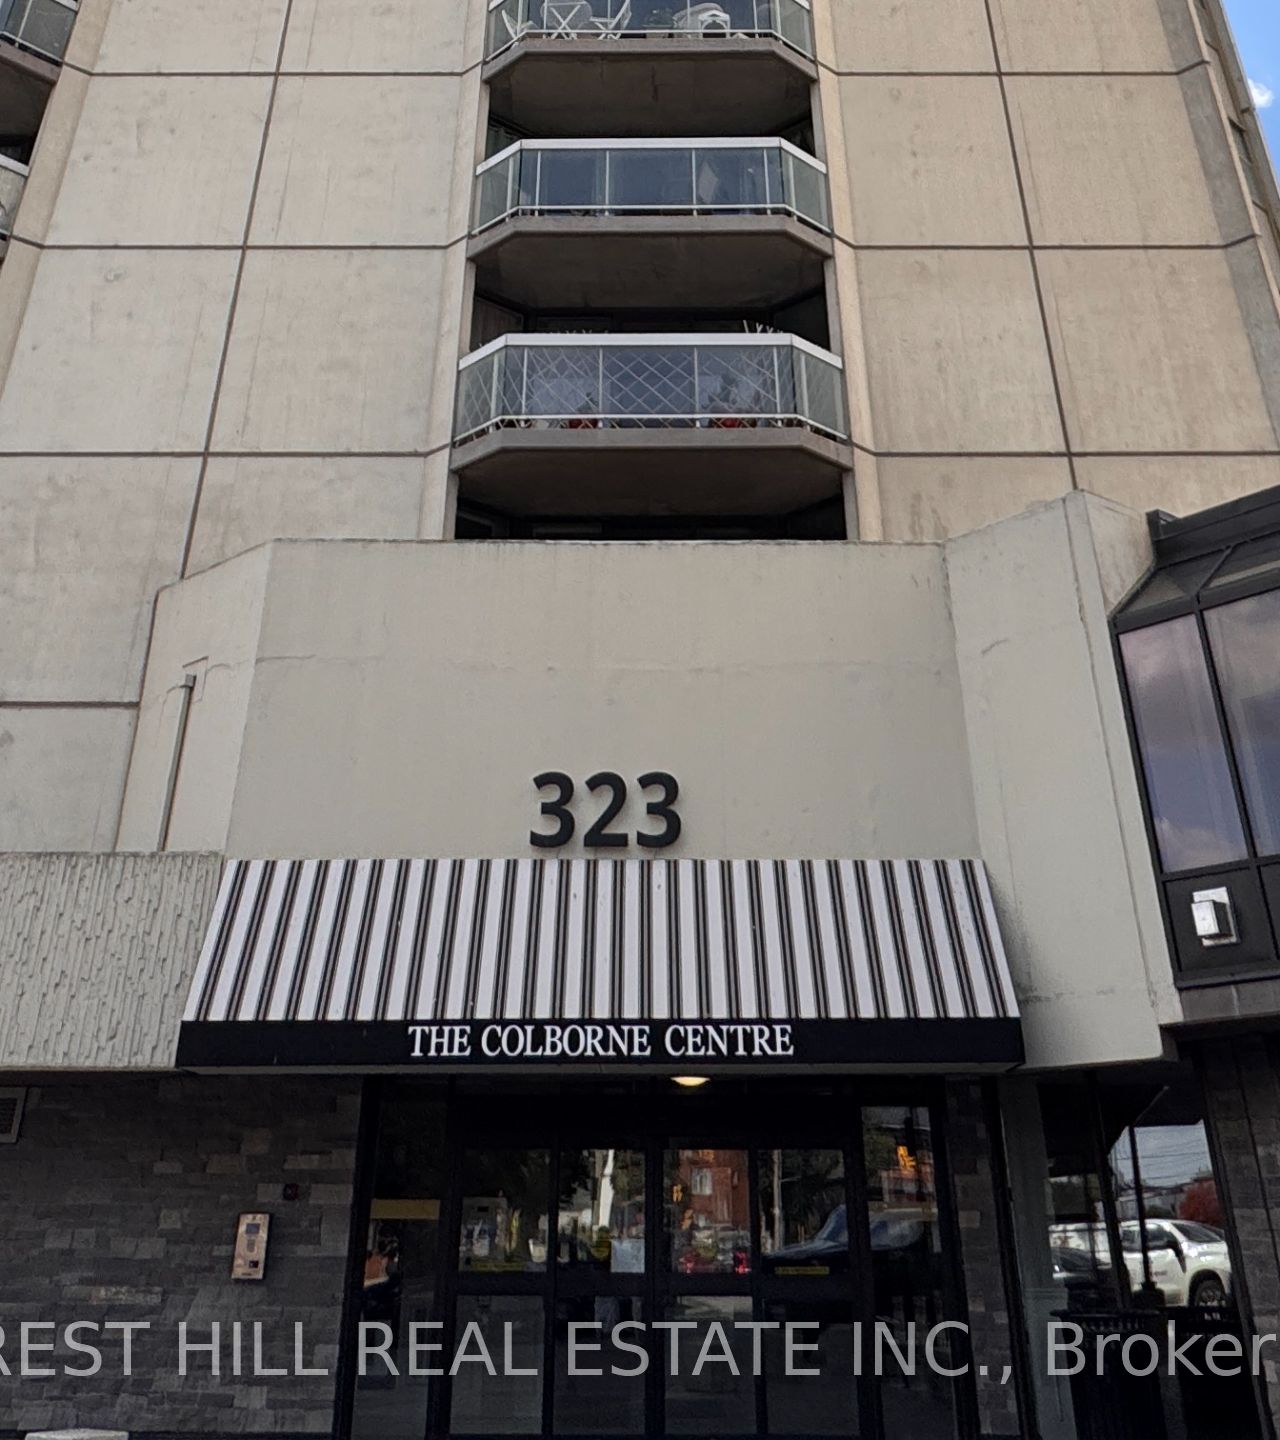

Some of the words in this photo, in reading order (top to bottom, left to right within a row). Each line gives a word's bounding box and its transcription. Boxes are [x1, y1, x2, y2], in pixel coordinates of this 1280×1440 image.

[529, 771, 681, 848] 323
[408, 1025, 471, 1057] THE
[481, 1024, 652, 1057] COLBORNE
[664, 1024, 794, 1057] CENTRE
